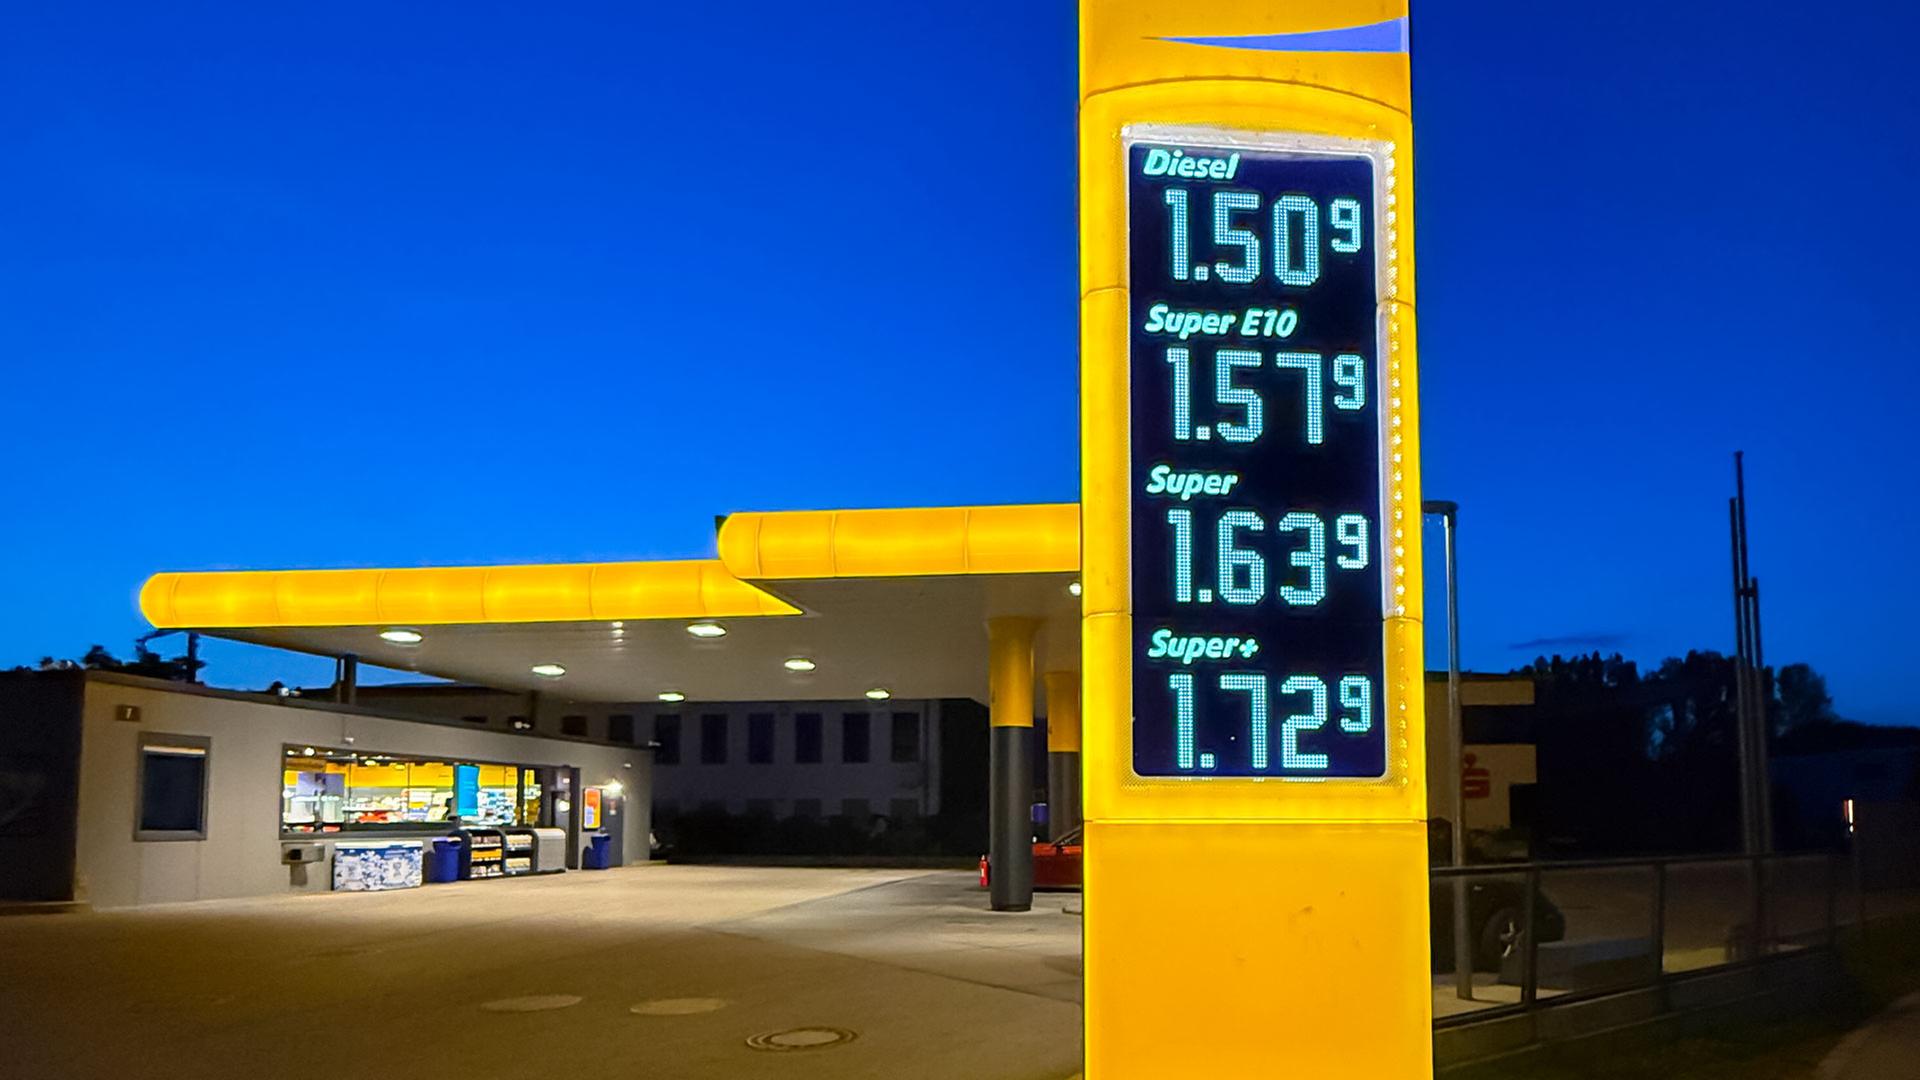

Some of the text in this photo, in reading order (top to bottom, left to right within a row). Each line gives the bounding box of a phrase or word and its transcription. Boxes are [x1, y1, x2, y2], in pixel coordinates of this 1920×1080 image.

[1143, 149, 1240, 179] Diesel
[1145, 304, 1297, 340] Super E10
[1146, 465, 1238, 500] Super
[1148, 629, 1258, 664] Super+
